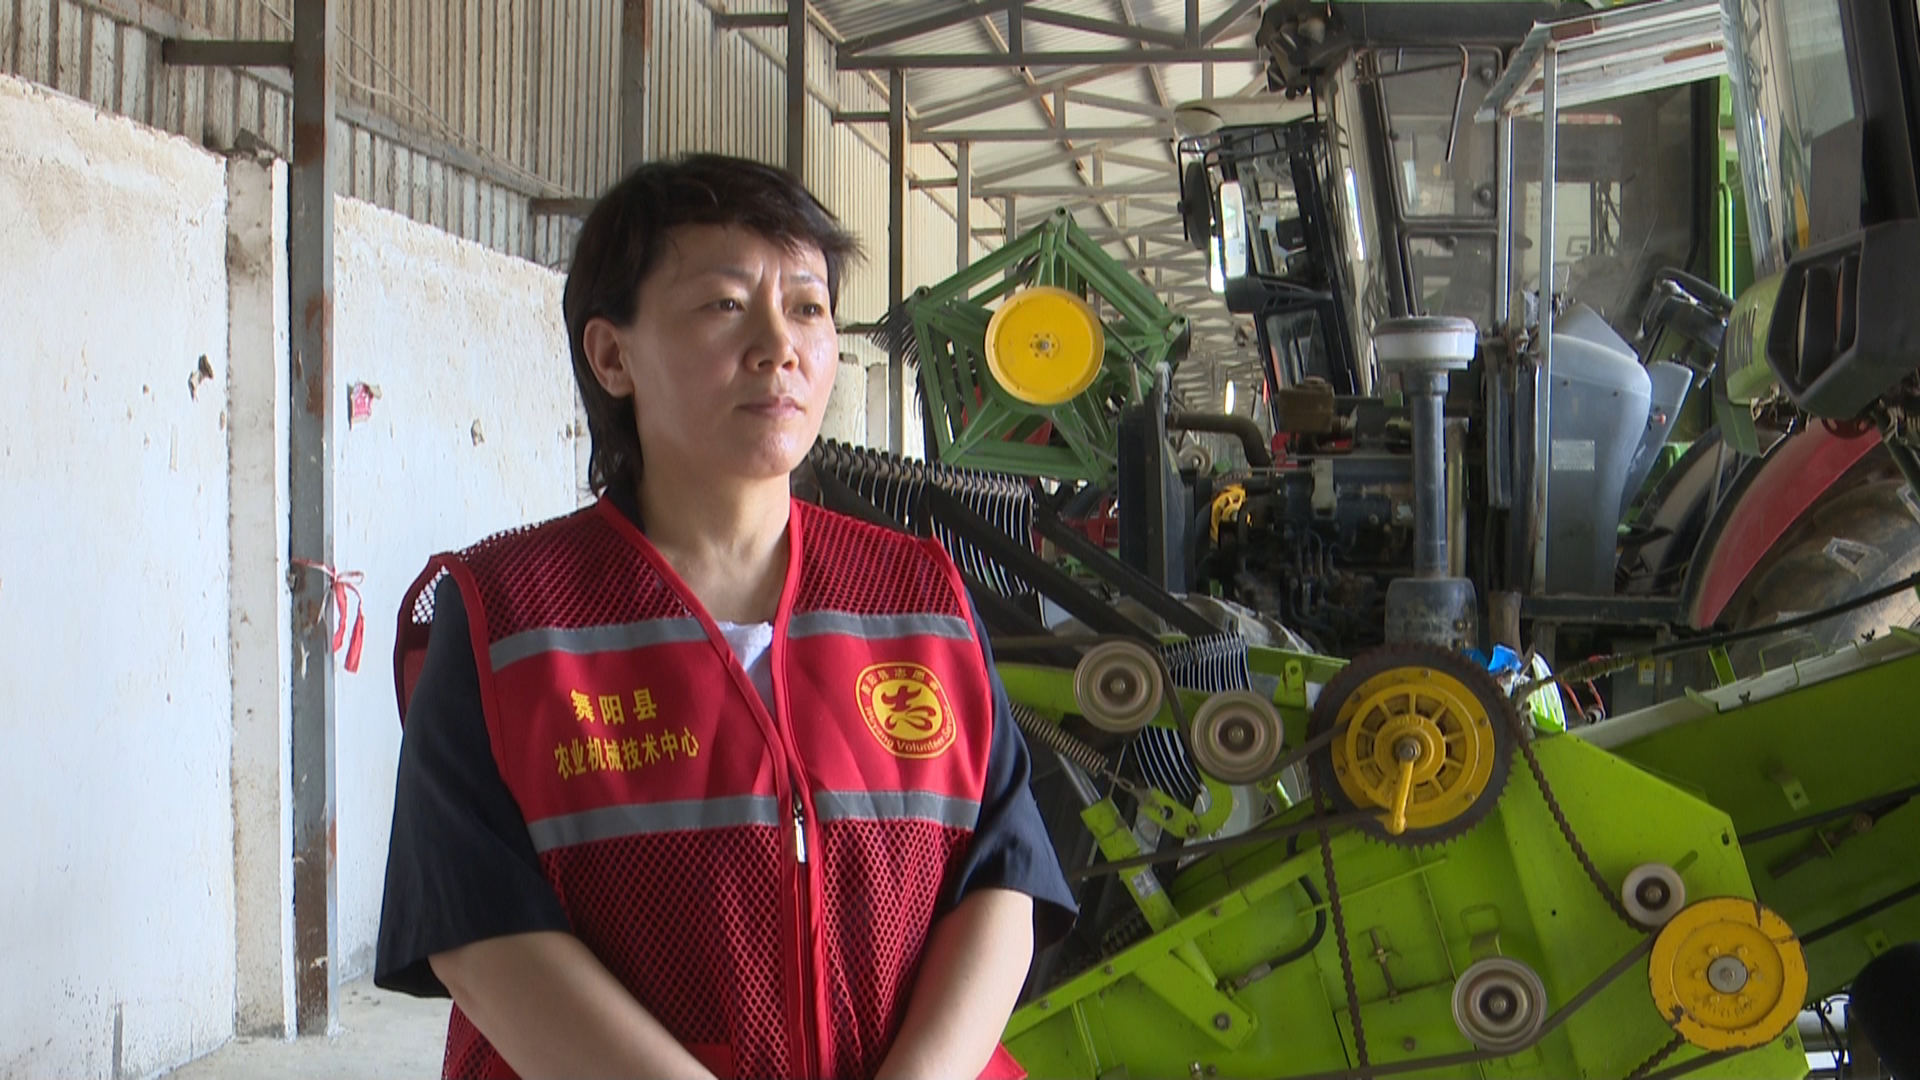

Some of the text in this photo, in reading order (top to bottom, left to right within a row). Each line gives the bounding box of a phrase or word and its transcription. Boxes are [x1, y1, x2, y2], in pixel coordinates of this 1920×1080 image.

[570, 688, 658, 725] 舞阳县
[554, 726, 700, 780] 农业机械技术中心
[896, 736, 945, 753] Volunteer
